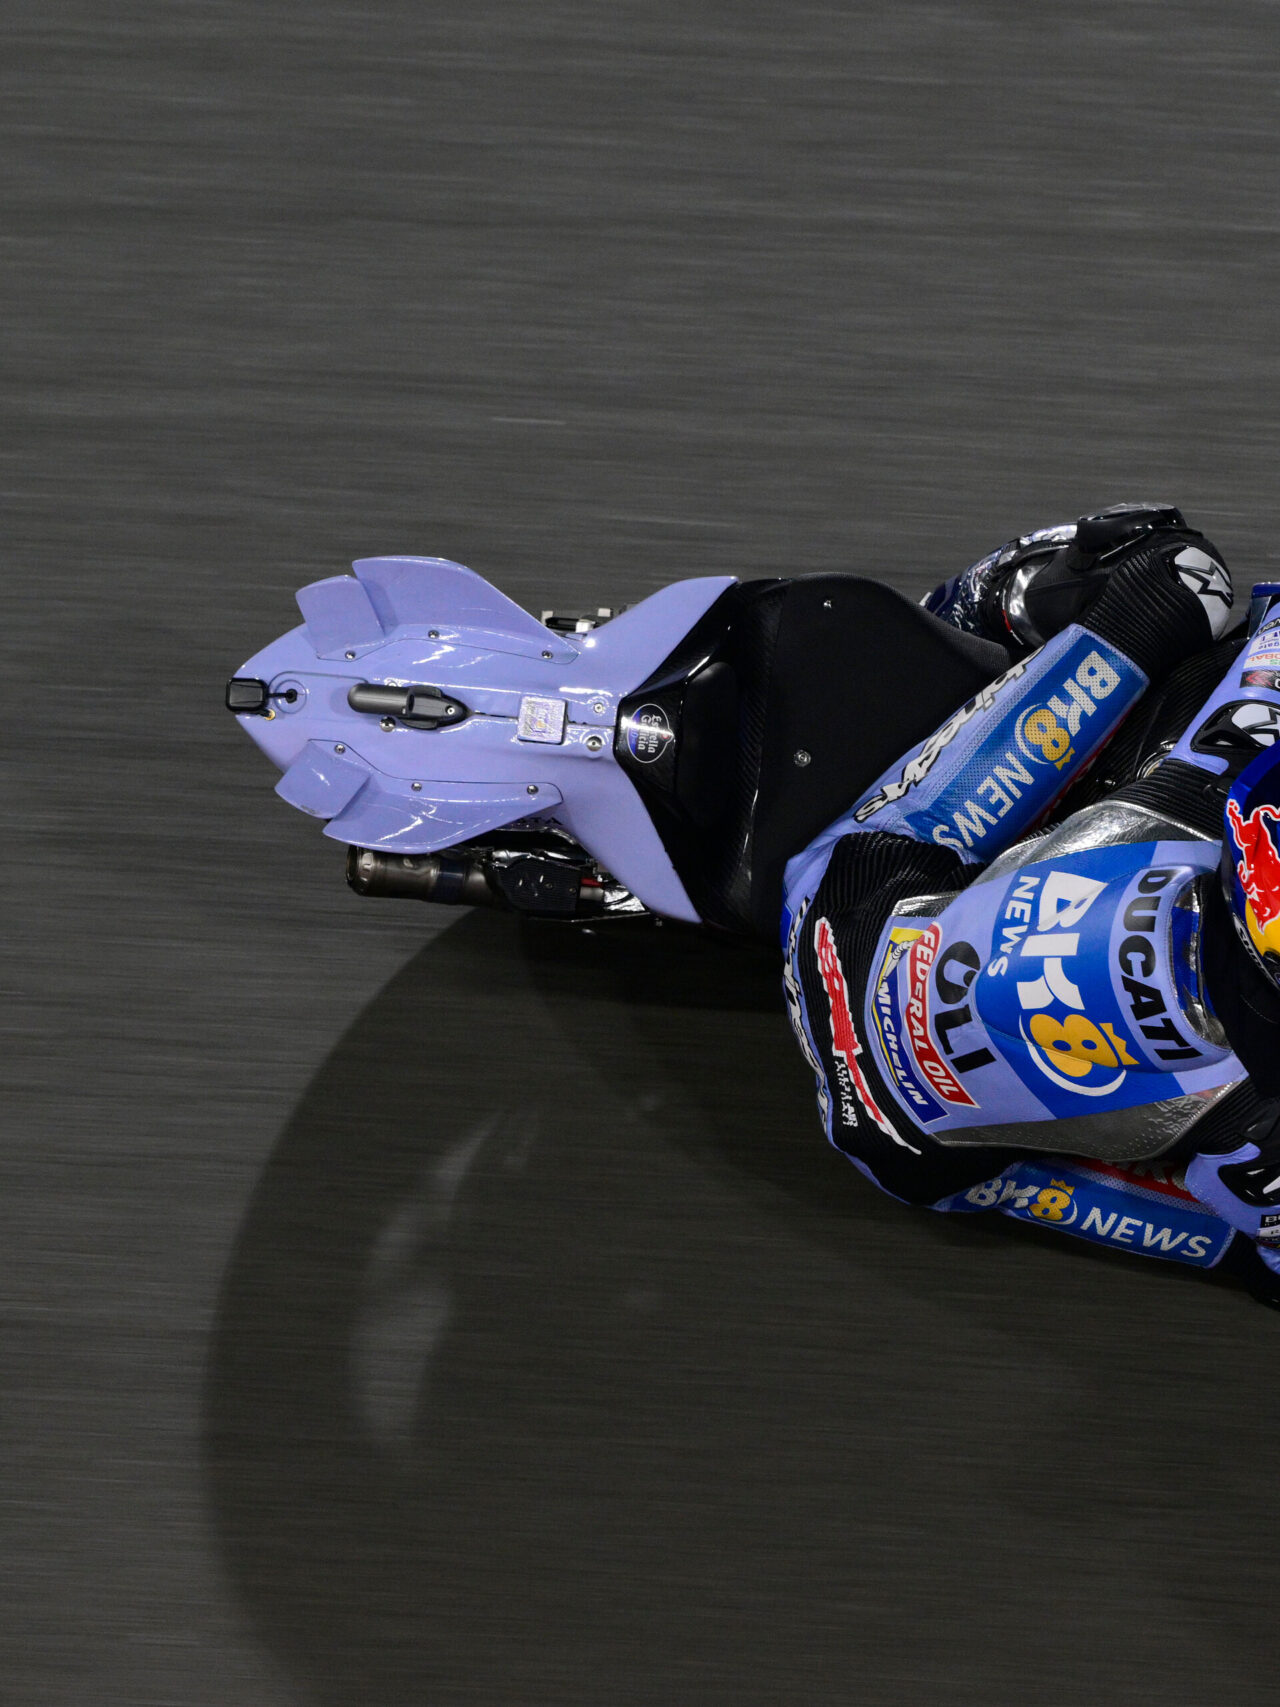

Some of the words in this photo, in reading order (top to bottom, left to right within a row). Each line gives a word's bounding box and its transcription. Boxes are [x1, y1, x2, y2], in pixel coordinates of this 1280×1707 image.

[647, 713, 662, 754] Esrella
[1014, 650, 1122, 770] BK8
[931, 751, 1035, 849] NEWS
[986, 875, 1041, 977] NEWS
[1016, 870, 1140, 1097] BK8
[1117, 868, 1204, 1062] DUCATI
[876, 979, 928, 1106] MICHELIN
[906, 929, 936, 1053] FEDERAL
[922, 1058, 961, 1107] OIL
[964, 1178, 1078, 1226] BK8
[1080, 1206, 1213, 1258] NEWS
